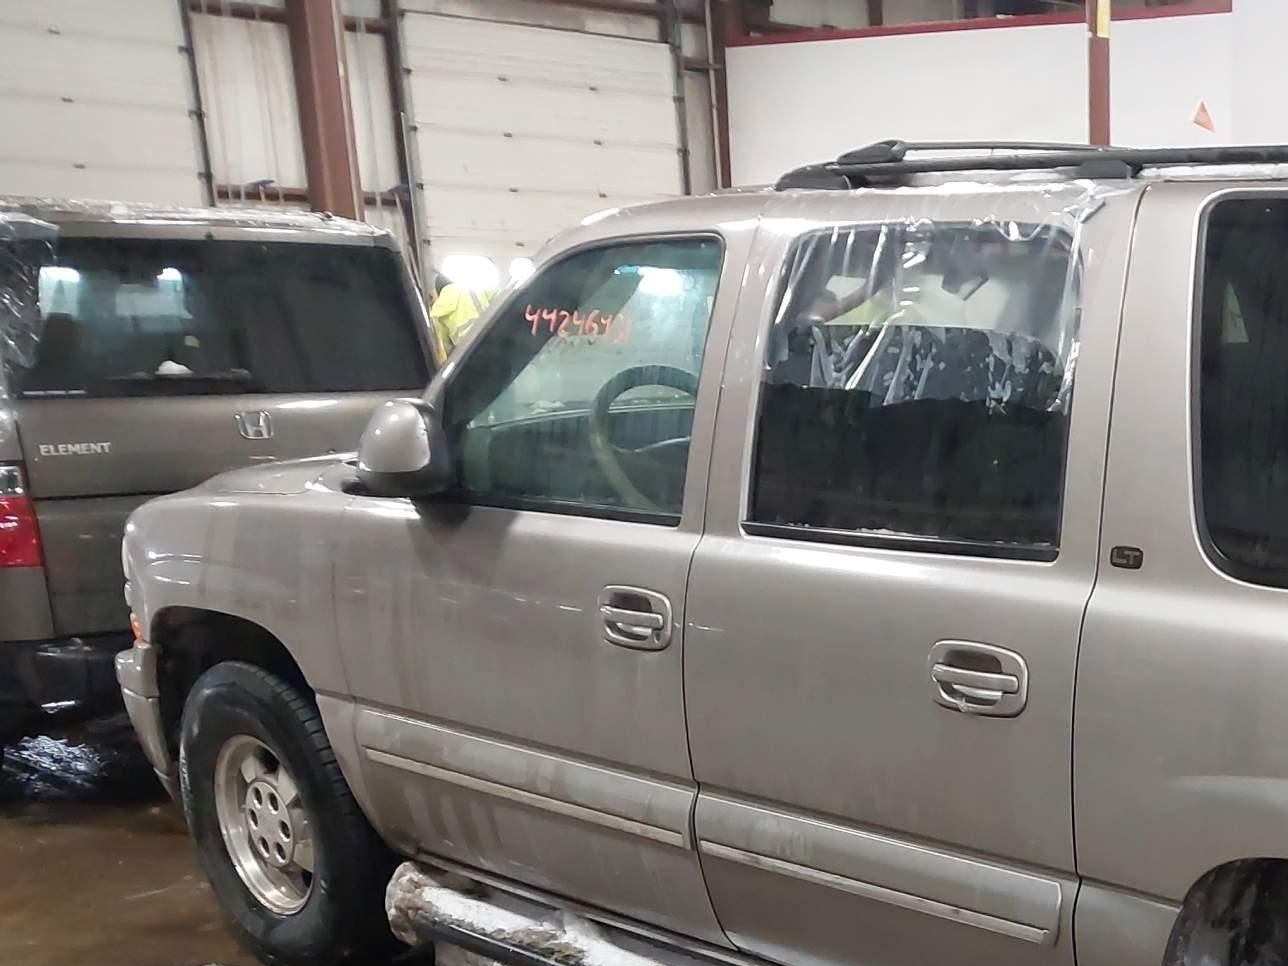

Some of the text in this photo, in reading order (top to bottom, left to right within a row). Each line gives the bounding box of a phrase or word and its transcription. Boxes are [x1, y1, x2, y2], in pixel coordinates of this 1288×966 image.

[525, 304, 632, 344] 44246
[39, 442, 112, 456] ELEMENT
[1112, 548, 1141, 566] LT
